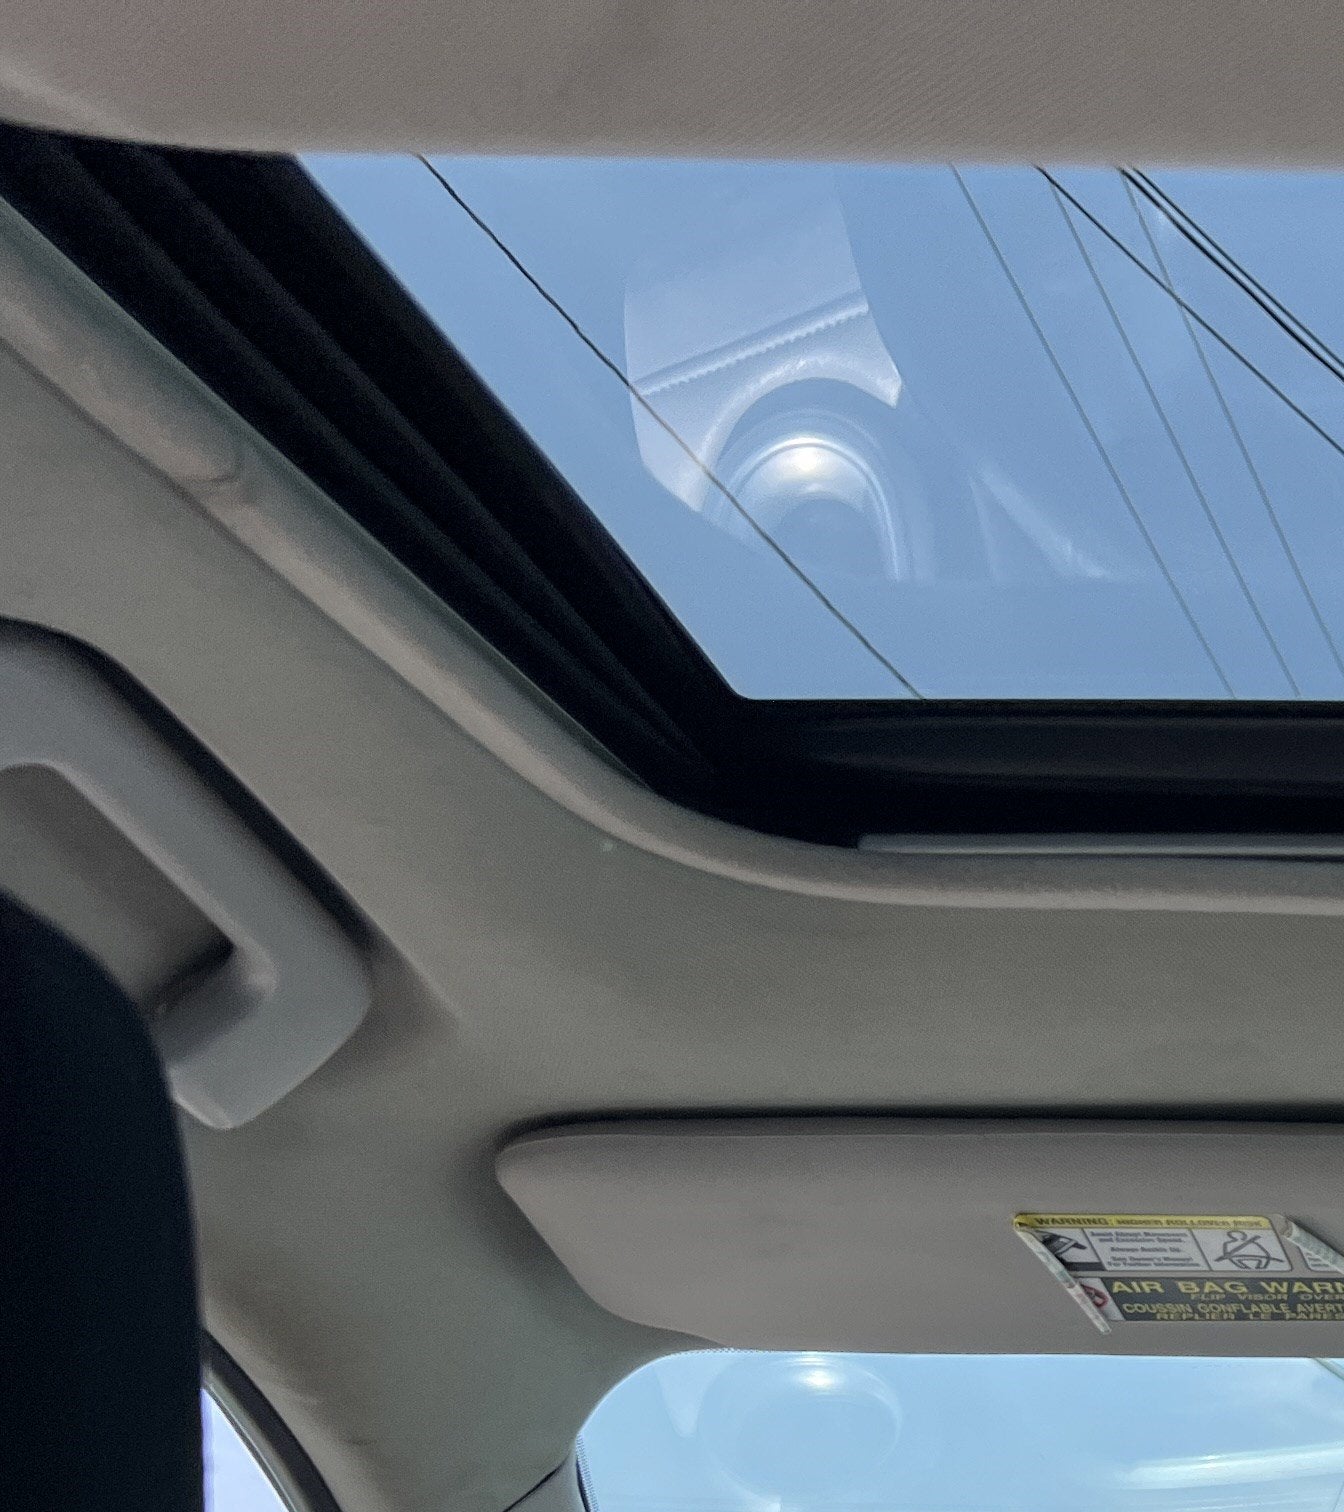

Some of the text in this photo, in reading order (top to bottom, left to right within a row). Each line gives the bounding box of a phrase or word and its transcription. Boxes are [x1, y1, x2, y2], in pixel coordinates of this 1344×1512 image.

[1112, 1281, 1165, 1294] AIR
[1176, 1281, 1248, 1294] BAG
[1122, 1303, 1193, 1314] COUSSIN
[1197, 1303, 1291, 1314] GONFLABLE
[1156, 1312, 1235, 1321] REPLIER
[1250, 1313, 1270, 1321] LE
